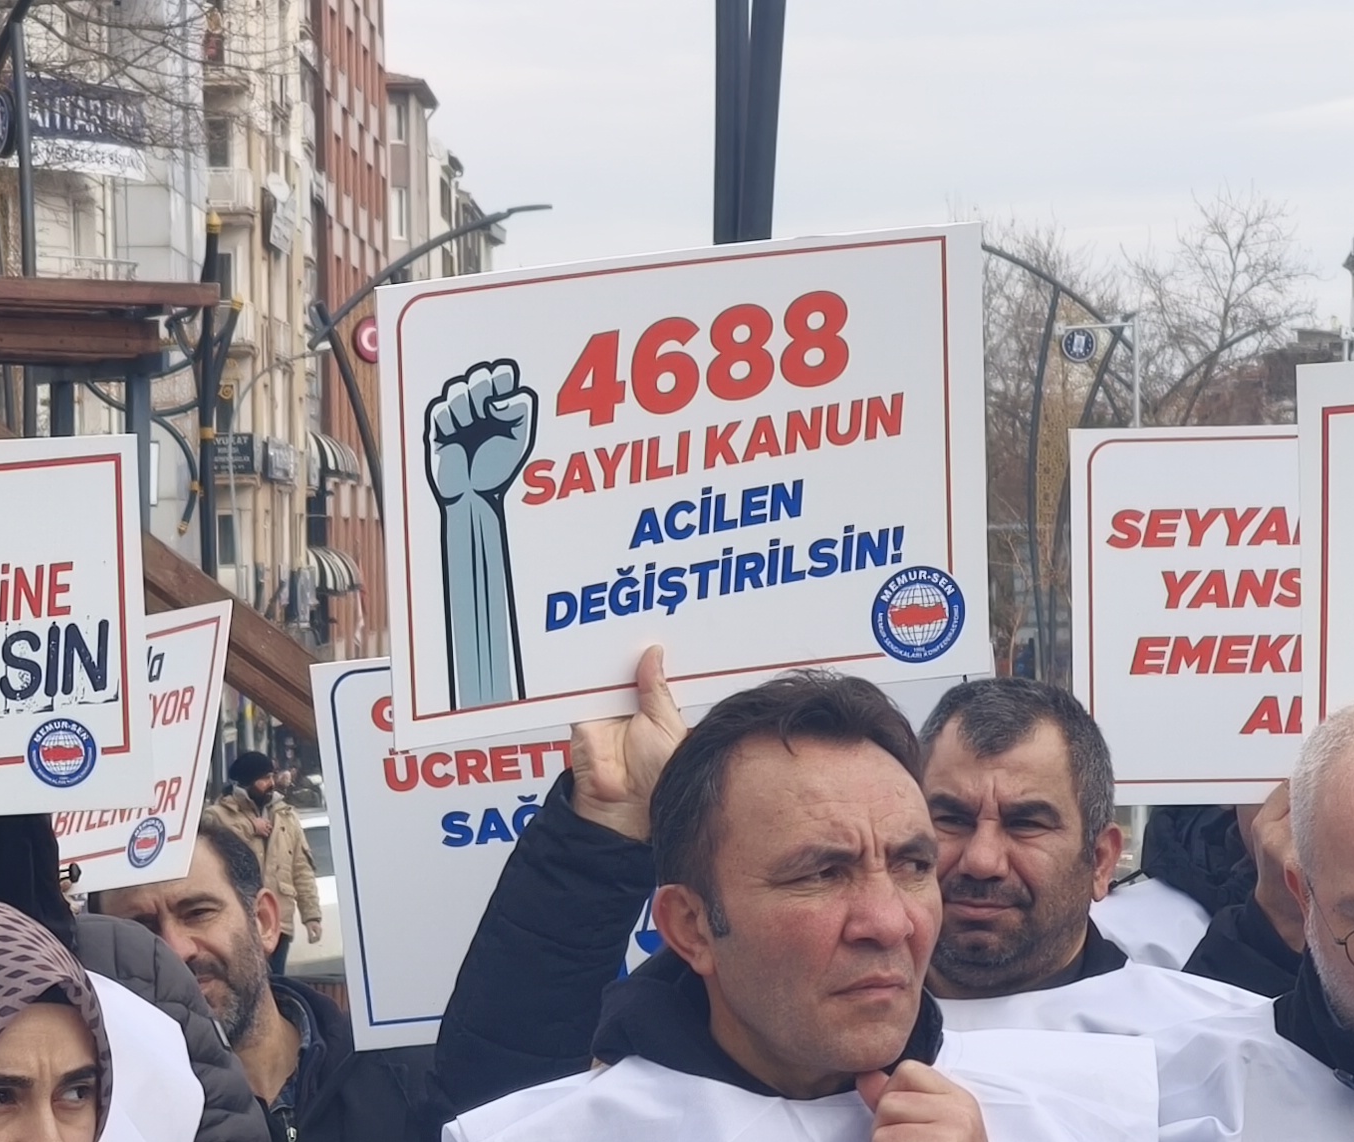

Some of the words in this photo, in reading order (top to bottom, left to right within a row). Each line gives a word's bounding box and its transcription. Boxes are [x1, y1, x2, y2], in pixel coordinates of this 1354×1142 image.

[556, 291, 849, 426] 4688
[522, 430, 690, 505] SAYILI
[704, 392, 903, 469] KANUN
[629, 479, 803, 549] ACİLEN
[1106, 507, 1301, 548] SEYYA
[546, 525, 904, 632] DEĞİŞTİRİLSİN!
[880, 570, 955, 602] MEMUR-SEN
[34, 721, 89, 743] MEMUR-SEN
